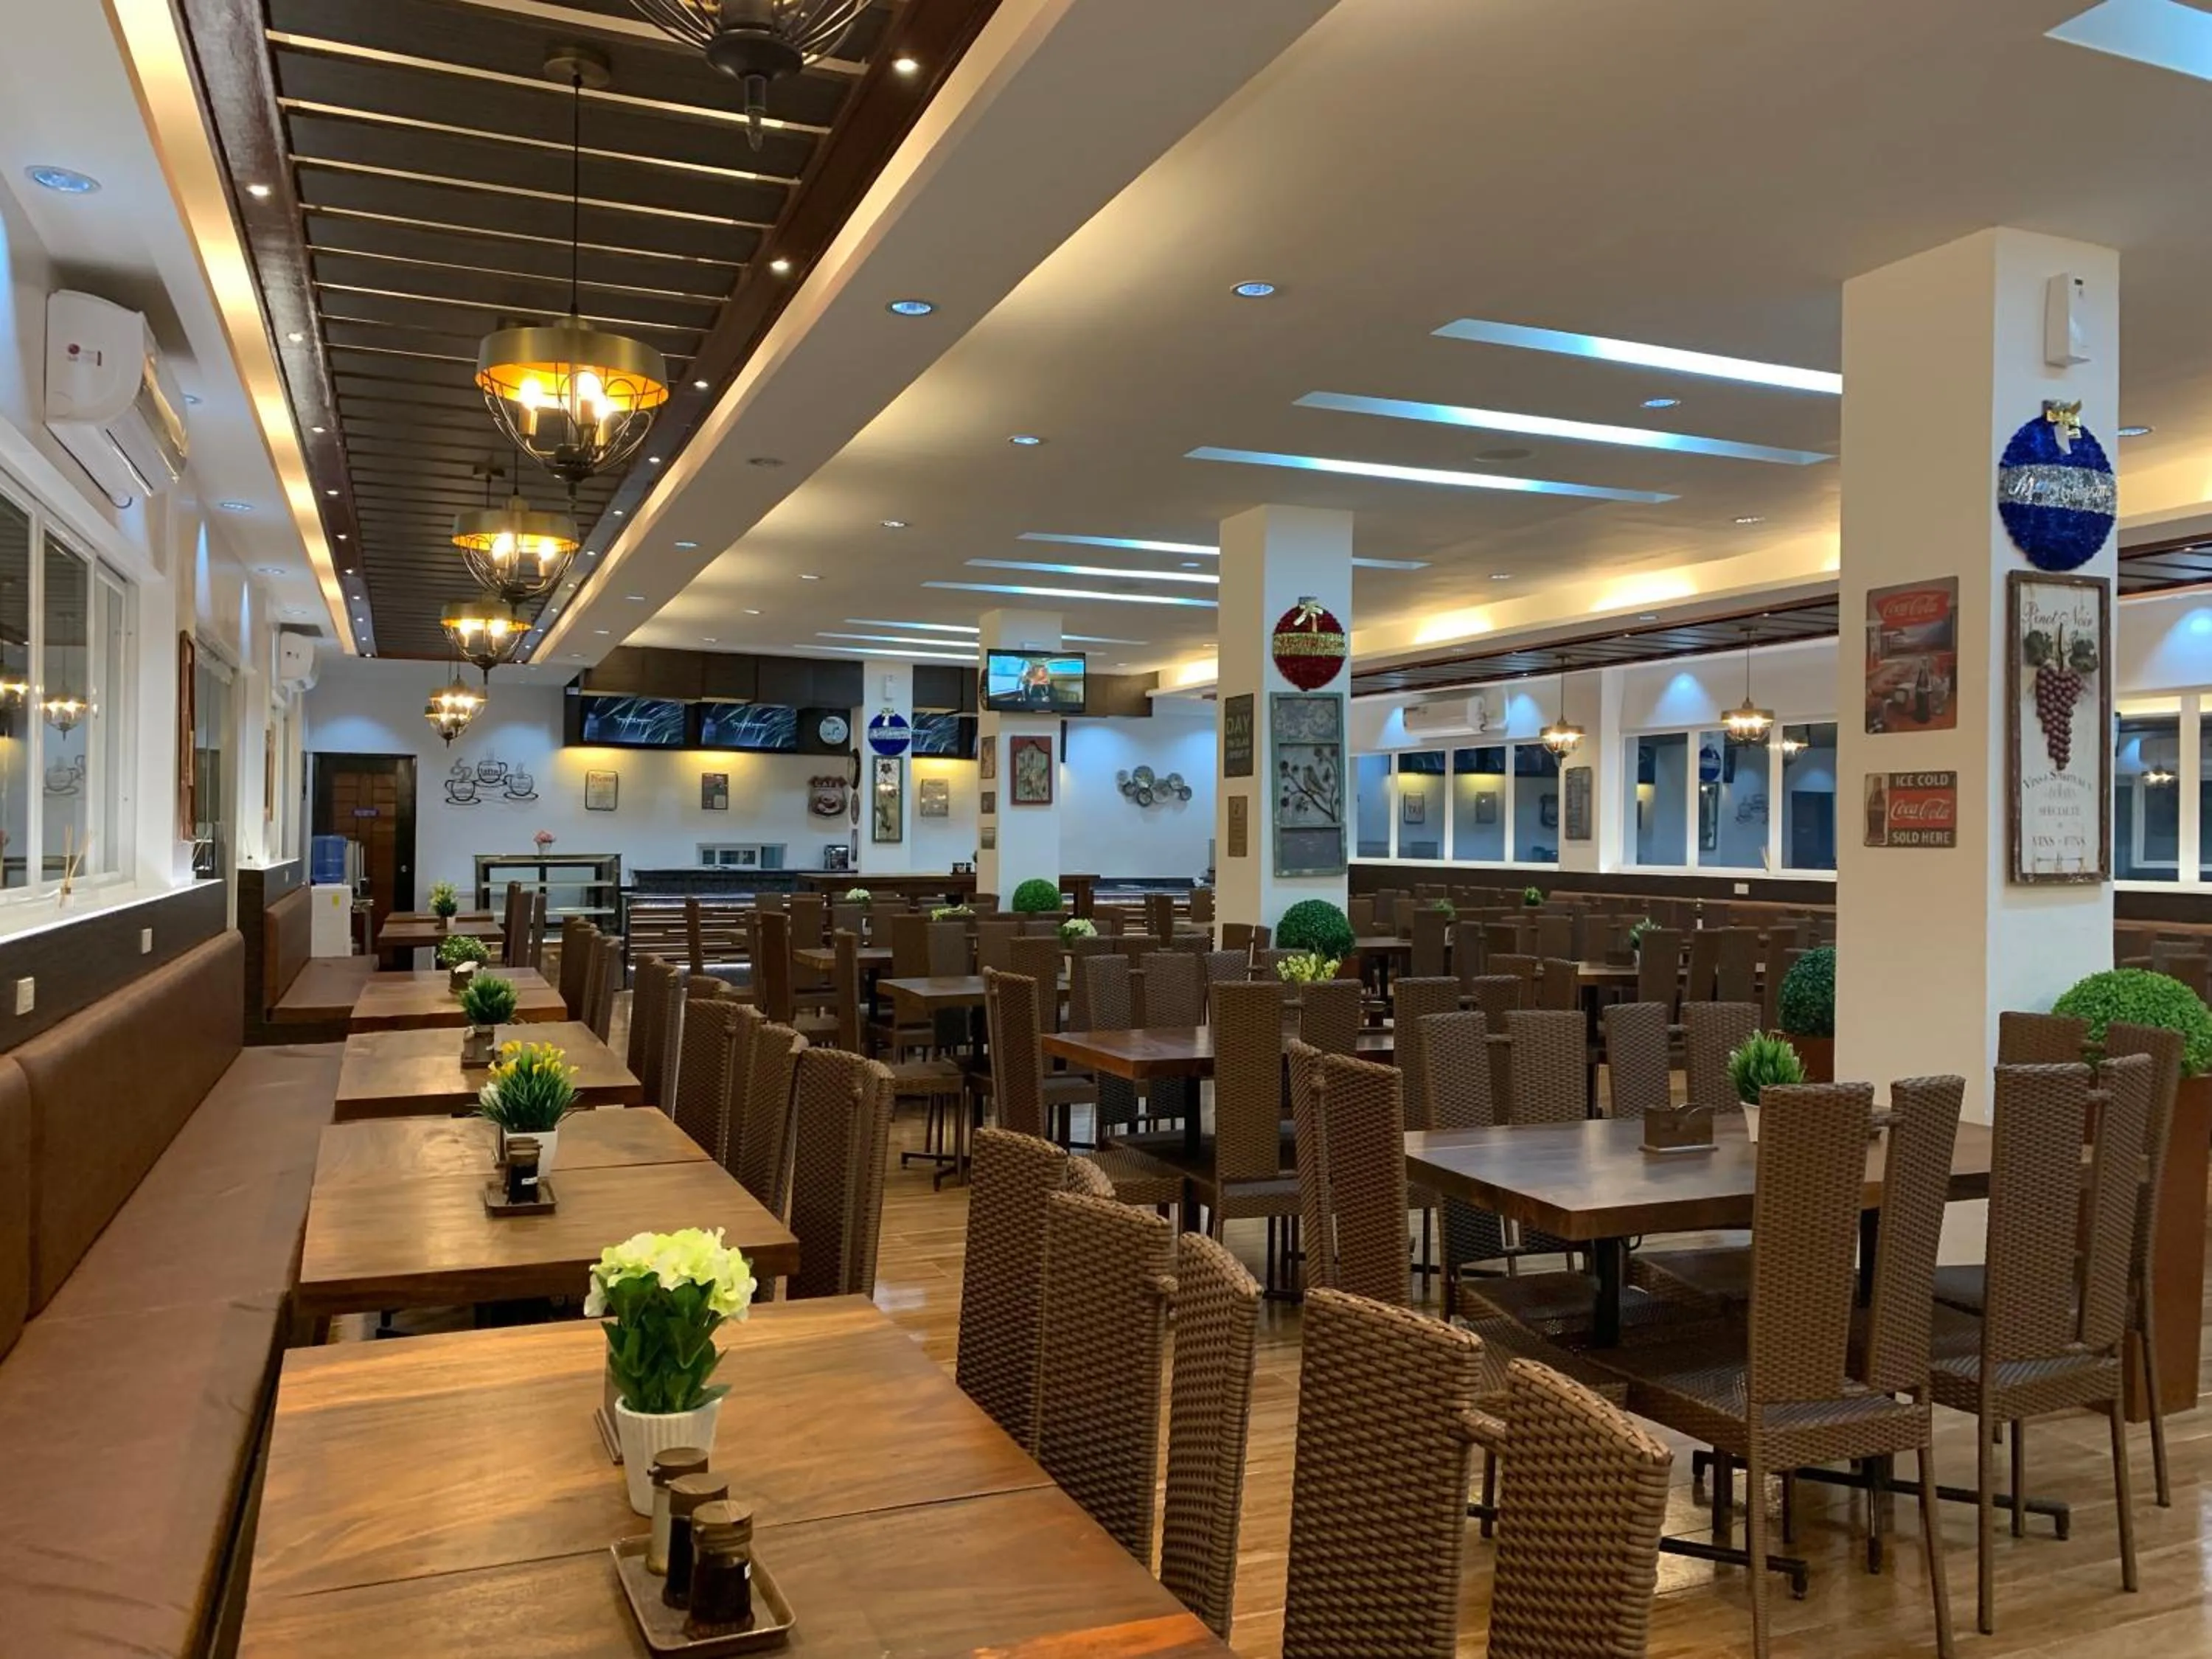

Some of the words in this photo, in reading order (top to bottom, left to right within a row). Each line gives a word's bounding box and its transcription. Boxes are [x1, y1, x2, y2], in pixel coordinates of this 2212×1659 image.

[1227, 713, 1250, 734] DAY
[1896, 775, 1914, 787] ICE
[1918, 774, 1949, 785] COLD
[1891, 799, 1950, 820] Coca-Cola
[1893, 832, 1919, 844] SOLD
[1921, 831, 1950, 844] HERE
